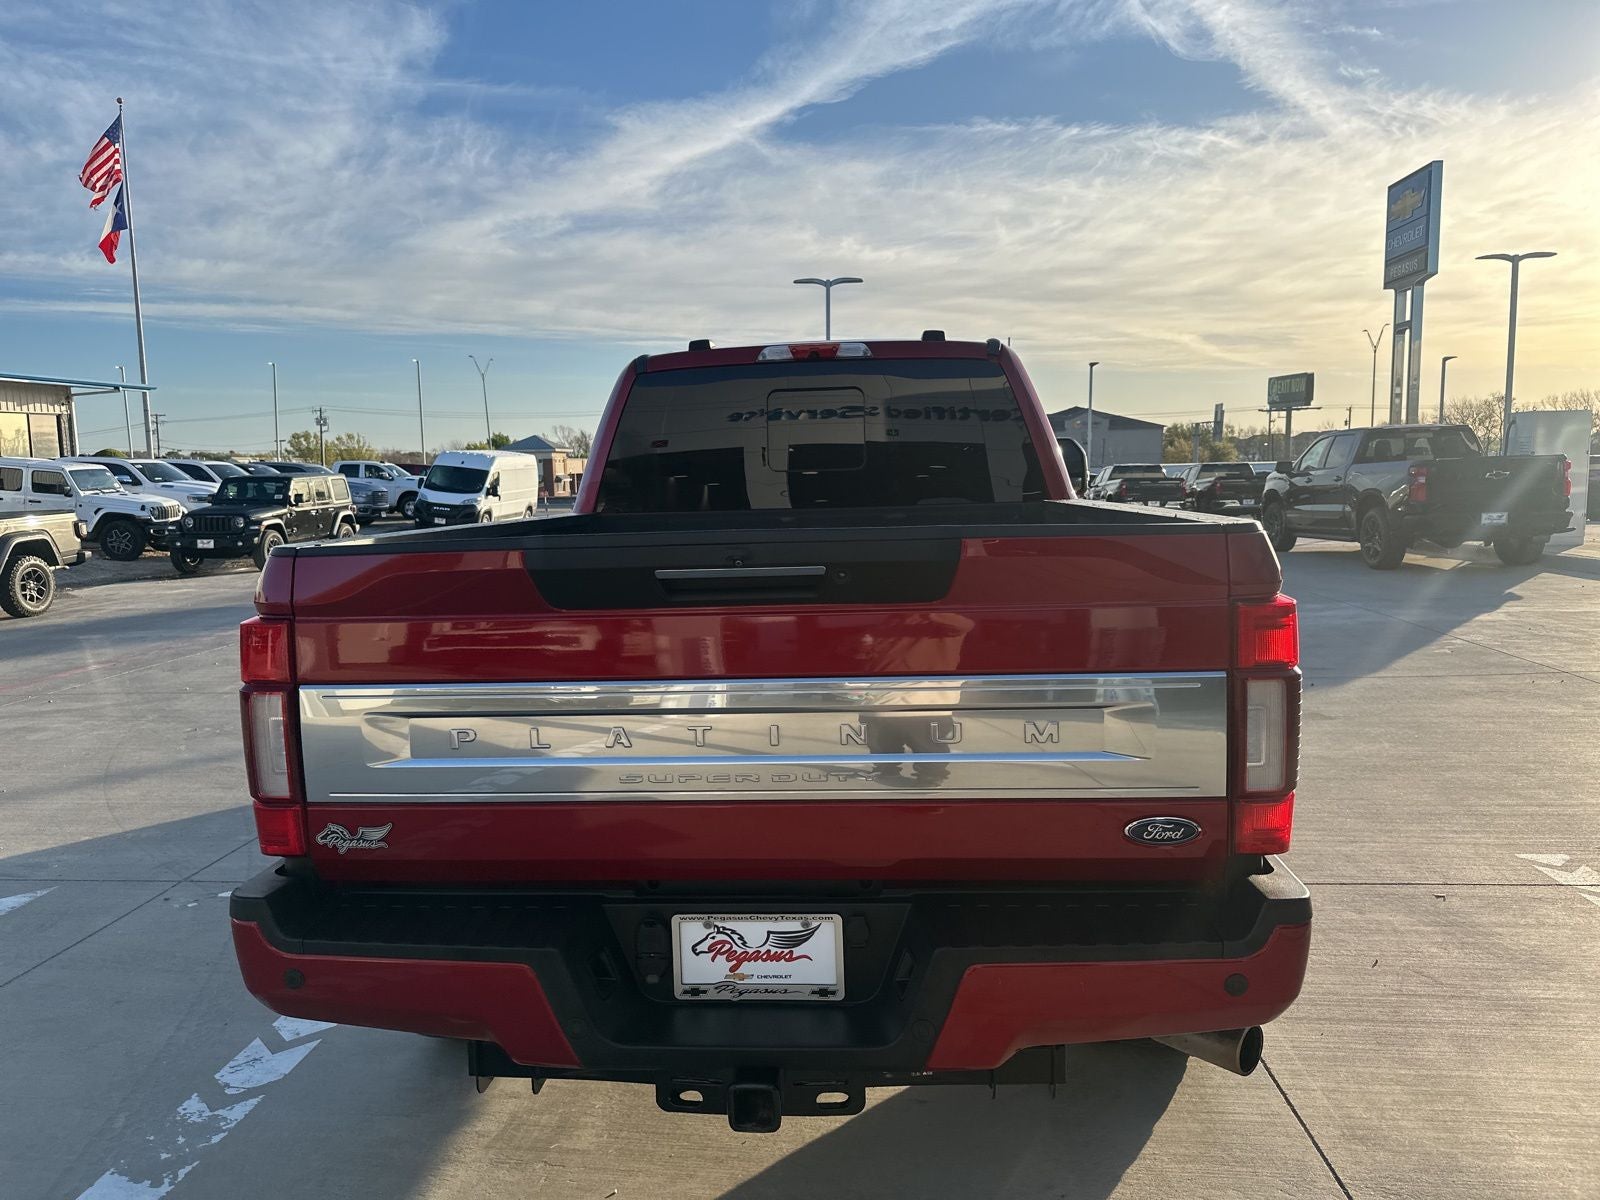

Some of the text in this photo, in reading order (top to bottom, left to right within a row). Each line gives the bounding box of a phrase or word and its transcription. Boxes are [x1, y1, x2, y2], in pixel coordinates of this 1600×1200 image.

[1388, 224, 1425, 251] CHEVROLET
[1391, 258, 1418, 278] PEGASUS
[449, 720, 1060, 750] PLATINUM
[618, 770, 882, 785] SUPER DUTY
[1143, 823, 1185, 840] Ford
[326, 833, 388, 854] Pegasus
[707, 939, 813, 974] Pegasus
[714, 983, 804, 998] Pegasus
